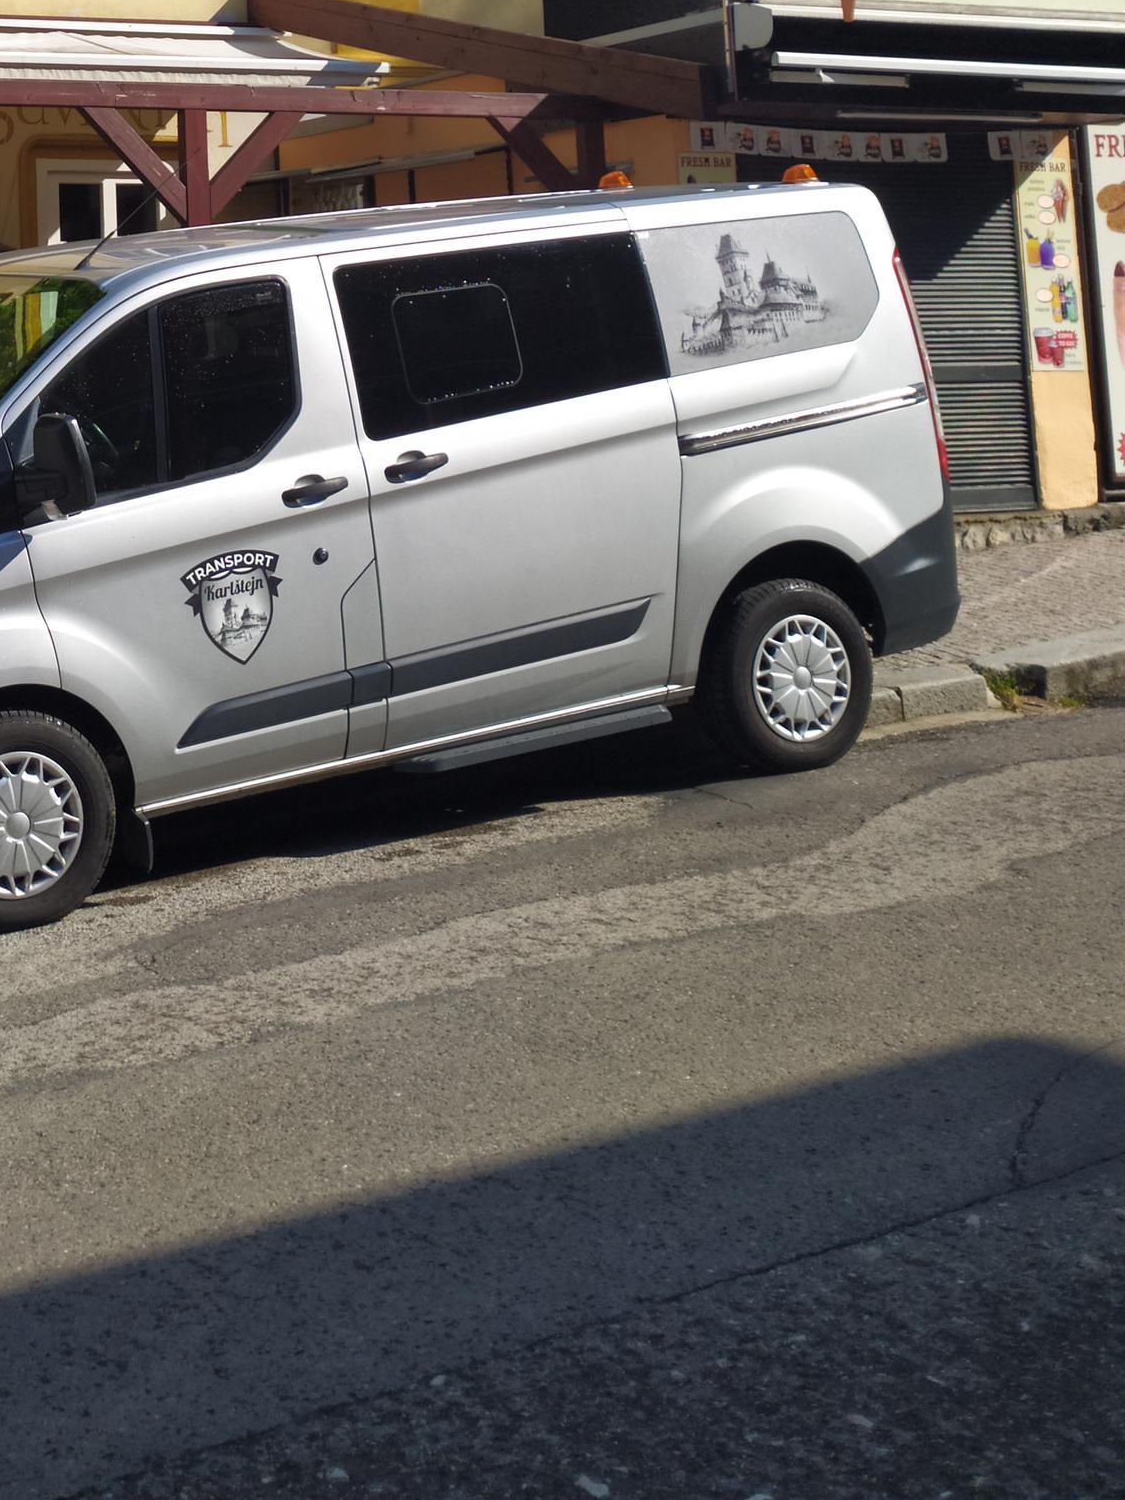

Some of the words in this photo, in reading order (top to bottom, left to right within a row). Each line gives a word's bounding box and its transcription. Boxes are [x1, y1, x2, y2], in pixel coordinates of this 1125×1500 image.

[1093, 133, 1125, 158] FR
[713, 156, 732, 168] BAR
[1049, 162, 1067, 173] BAR
[185, 552, 274, 586] TRANSPORT
[203, 576, 264, 602] Karlštejn
